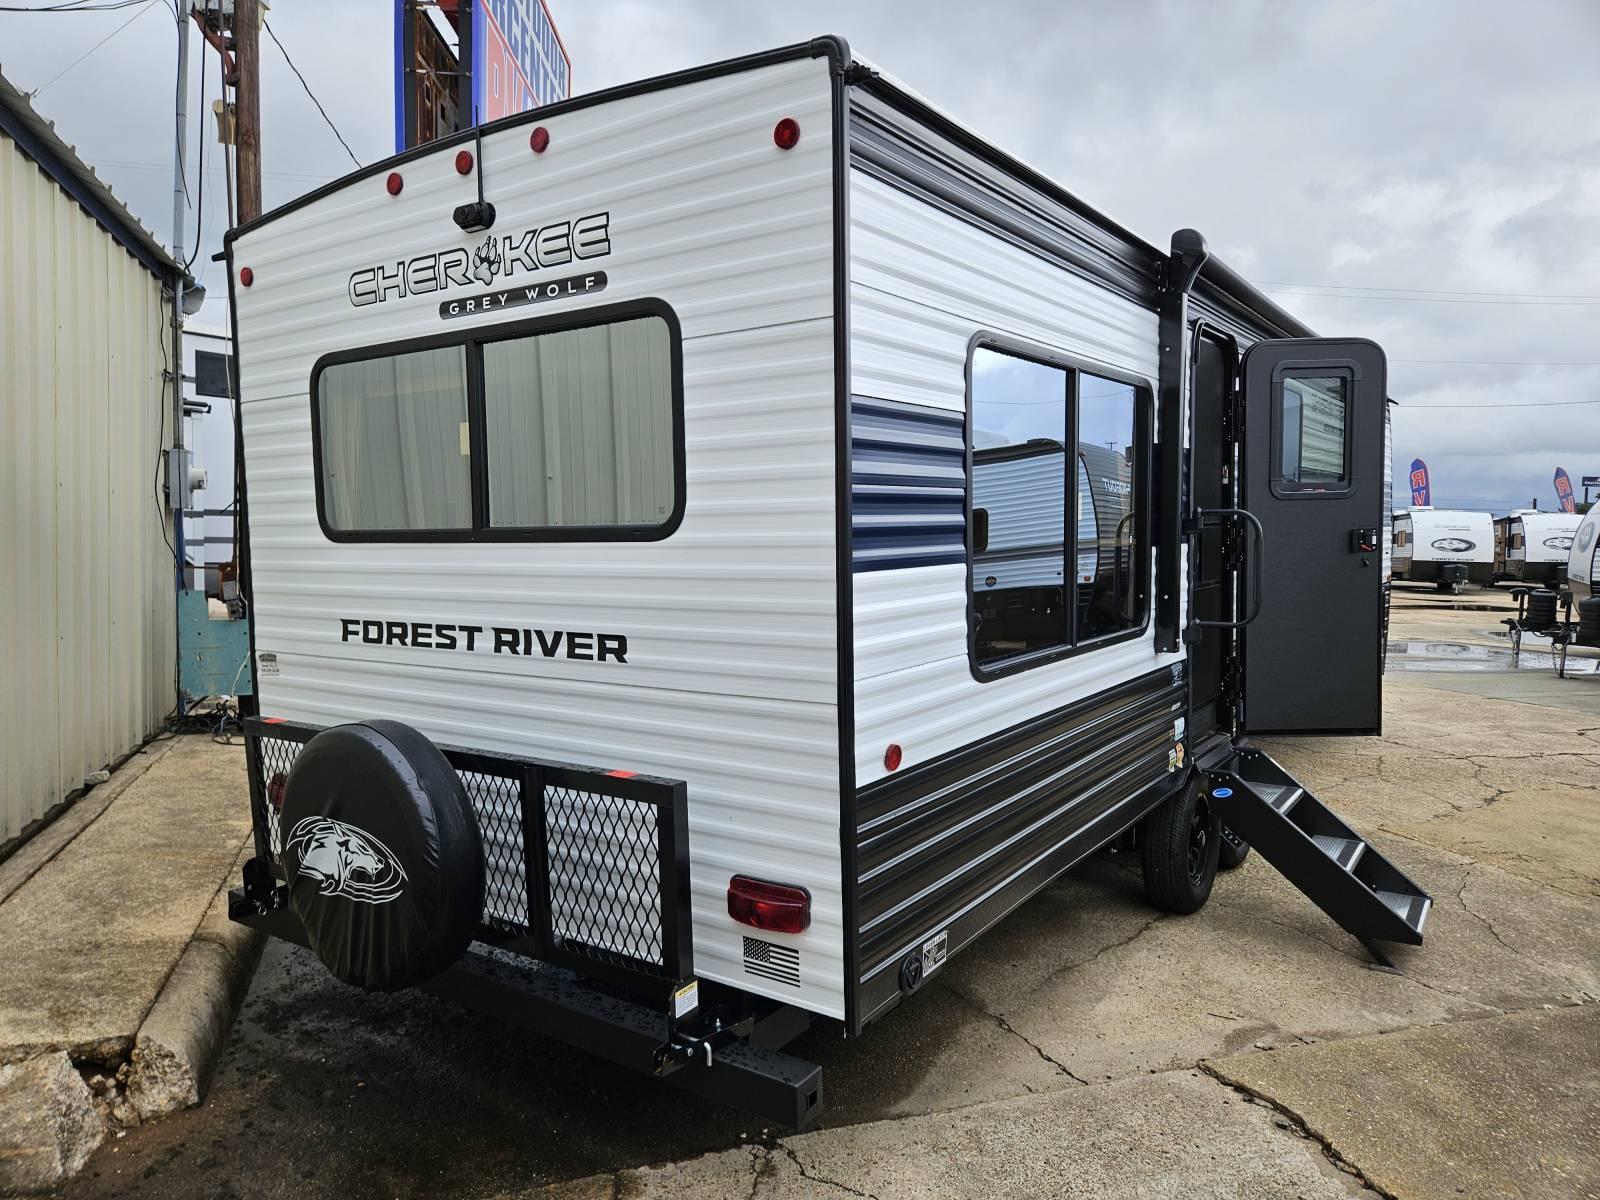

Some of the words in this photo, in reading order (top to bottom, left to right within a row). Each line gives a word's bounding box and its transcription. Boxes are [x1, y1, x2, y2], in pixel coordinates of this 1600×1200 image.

[348, 211, 612, 307] CHEROKEE
[449, 294, 509, 316] GREY
[525, 275, 597, 301] WOLF
[339, 617, 483, 652] FOREST
[491, 626, 629, 664] RIVER
